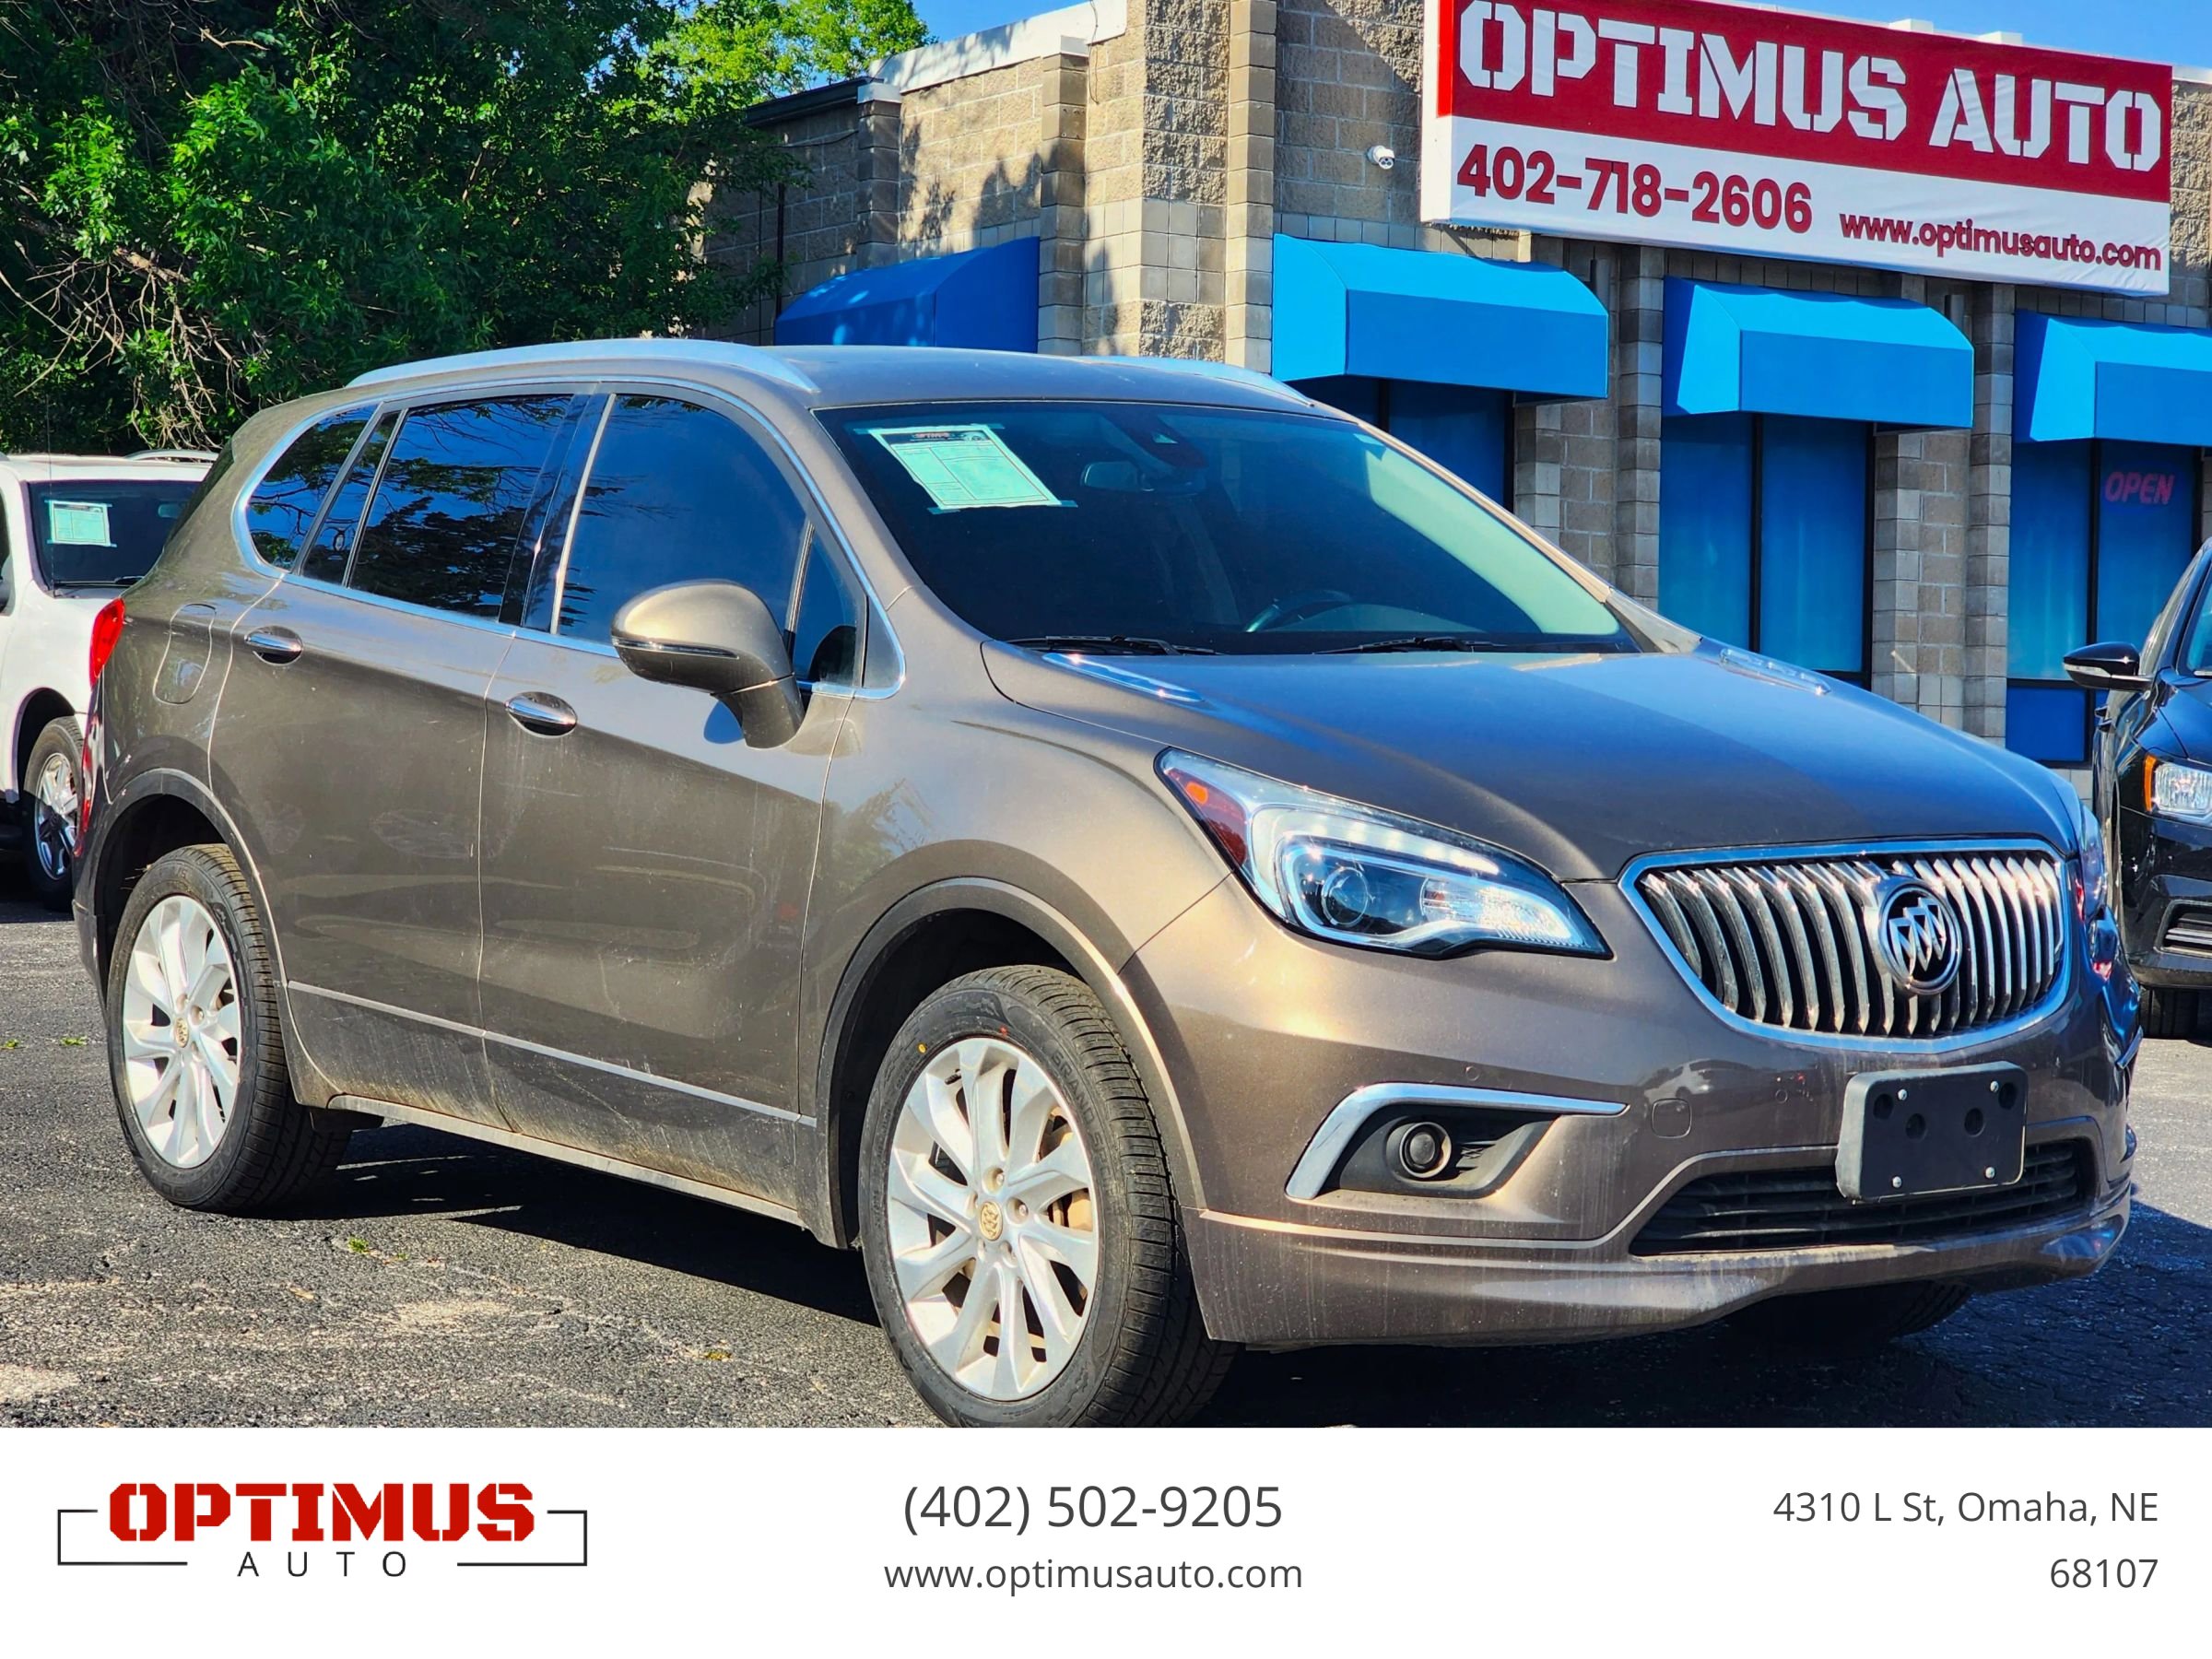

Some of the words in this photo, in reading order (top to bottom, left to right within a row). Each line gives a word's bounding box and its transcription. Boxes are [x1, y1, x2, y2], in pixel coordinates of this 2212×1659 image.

[1458, 0, 1908, 142] OPTIMUS
[1928, 67, 2161, 173] AUTO
[1456, 145, 1812, 234] 402-718-2606
[1839, 213, 2161, 271] www.optimusauto.com
[2103, 471, 2176, 505] OPEN
